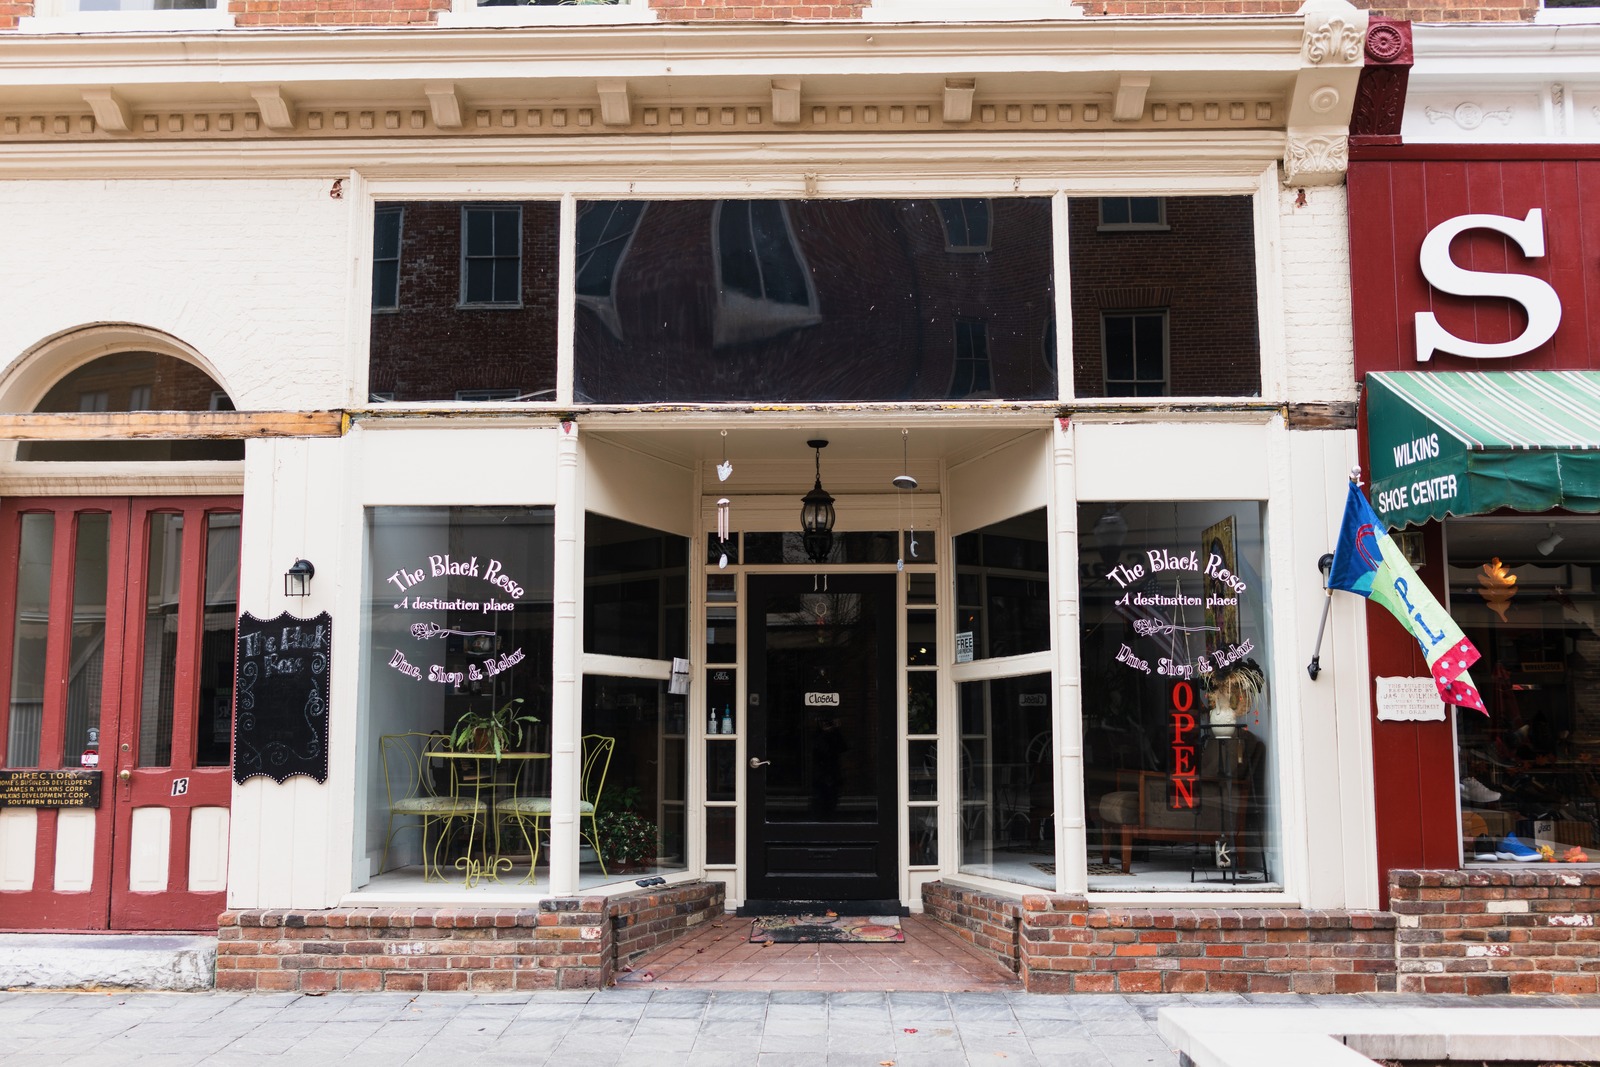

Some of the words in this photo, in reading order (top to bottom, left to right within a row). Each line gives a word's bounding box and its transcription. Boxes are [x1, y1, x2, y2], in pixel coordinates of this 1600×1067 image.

[1415, 208, 1562, 362] S
[1393, 433, 1440, 468] WILKINS
[1378, 486, 1409, 514] SHOE
[1411, 474, 1457, 506] CENTER
[386, 568, 426, 593] The
[428, 554, 479, 578] Black
[483, 558, 525, 599] Rose
[1105, 563, 1145, 589] The
[1146, 549, 1199, 573] Black
[1204, 552, 1247, 594] Rose
[393, 596, 409, 610] A
[411, 596, 480, 611] destination
[482, 598, 515, 614] place
[1114, 592, 1130, 606] A
[1132, 592, 1202, 606] destination
[1205, 593, 1238, 609] place
[239, 631, 277, 658] The
[956, 638, 973, 649] FREE
[1115, 643, 1151, 675] Dine,
[1157, 657, 1193, 680] Shop
[1197, 656, 1213, 673] &
[1212, 638, 1254, 669] Relax
[388, 649, 422, 681] Dine,
[428, 664, 464, 688] Shop
[468, 664, 483, 680] &
[483, 647, 526, 677] Relax
[808, 694, 838, 704] Closed
[1171, 681, 1196, 809] OPEN
[11, 772, 80, 780] DIRECTORY
[173, 778, 188, 795] 13
